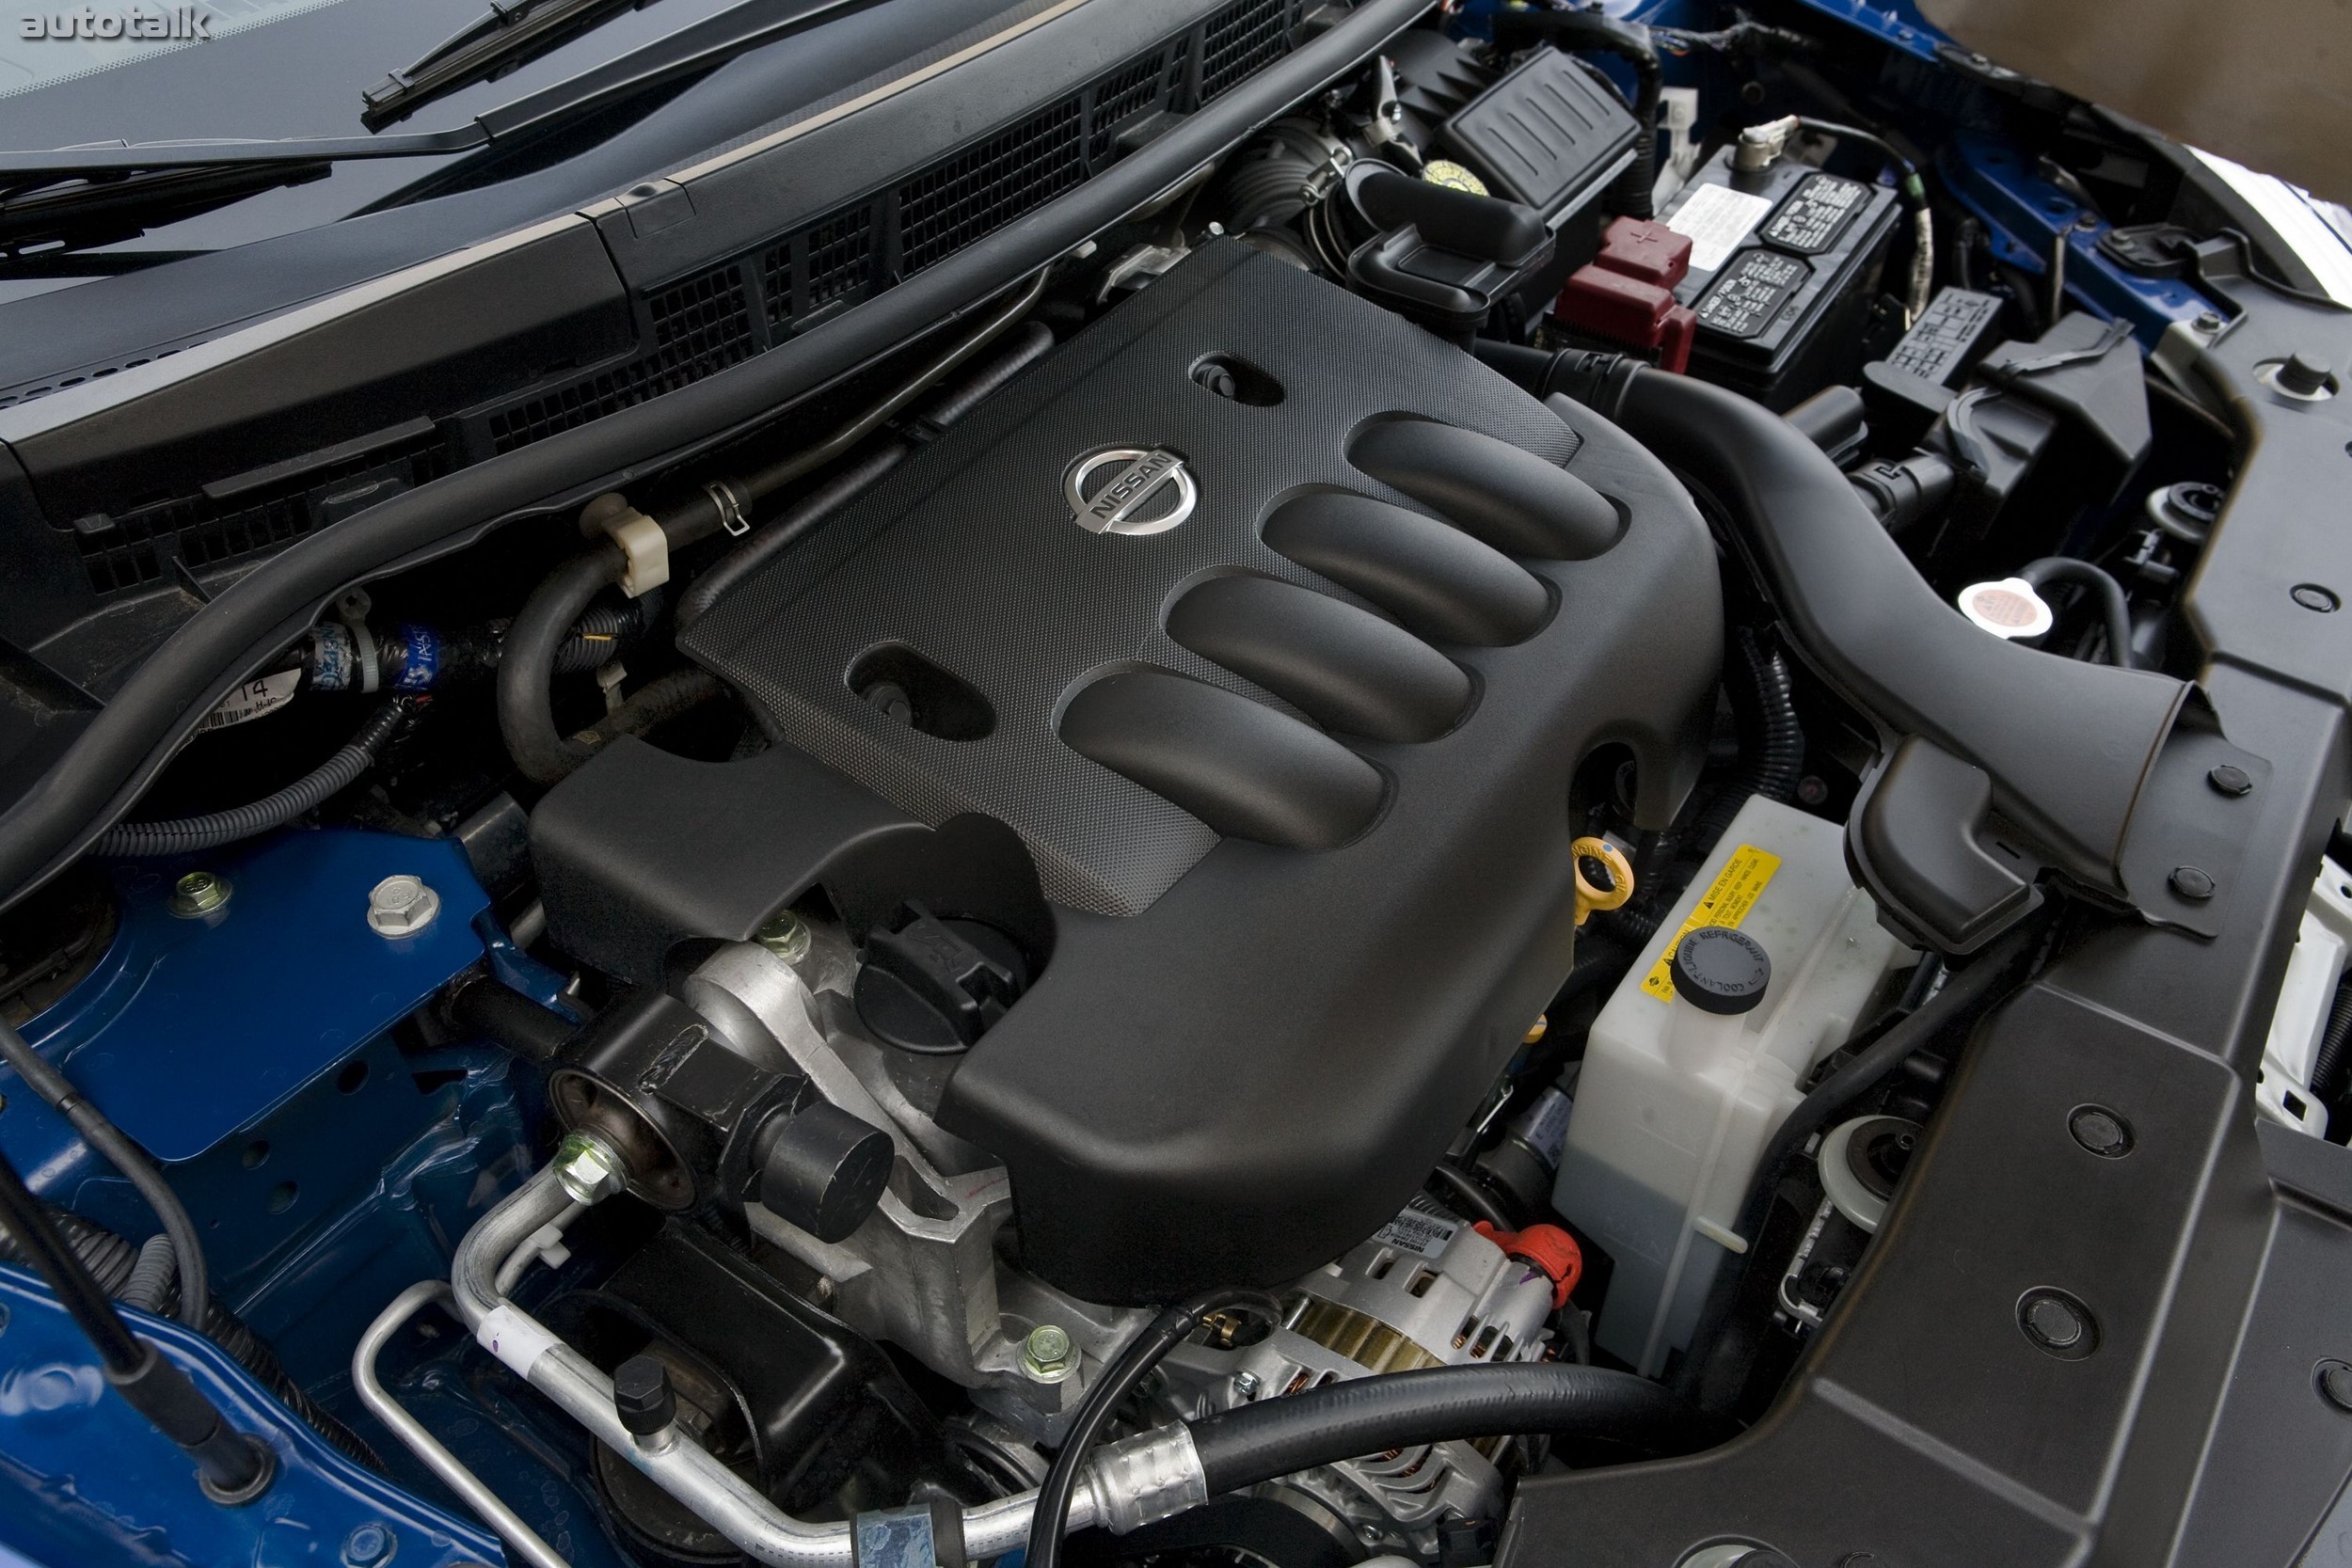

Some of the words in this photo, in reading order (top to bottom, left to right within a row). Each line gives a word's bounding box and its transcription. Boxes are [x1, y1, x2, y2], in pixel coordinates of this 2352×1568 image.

[1089, 452, 1172, 519] NISSAN
[1572, 846, 1613, 864] NGINE
[1708, 885, 1723, 901] MISE
[1718, 877, 1728, 887] EN
[1724, 858, 1742, 879] GARDE
[1391, 1239, 1424, 1253] NISSAN
